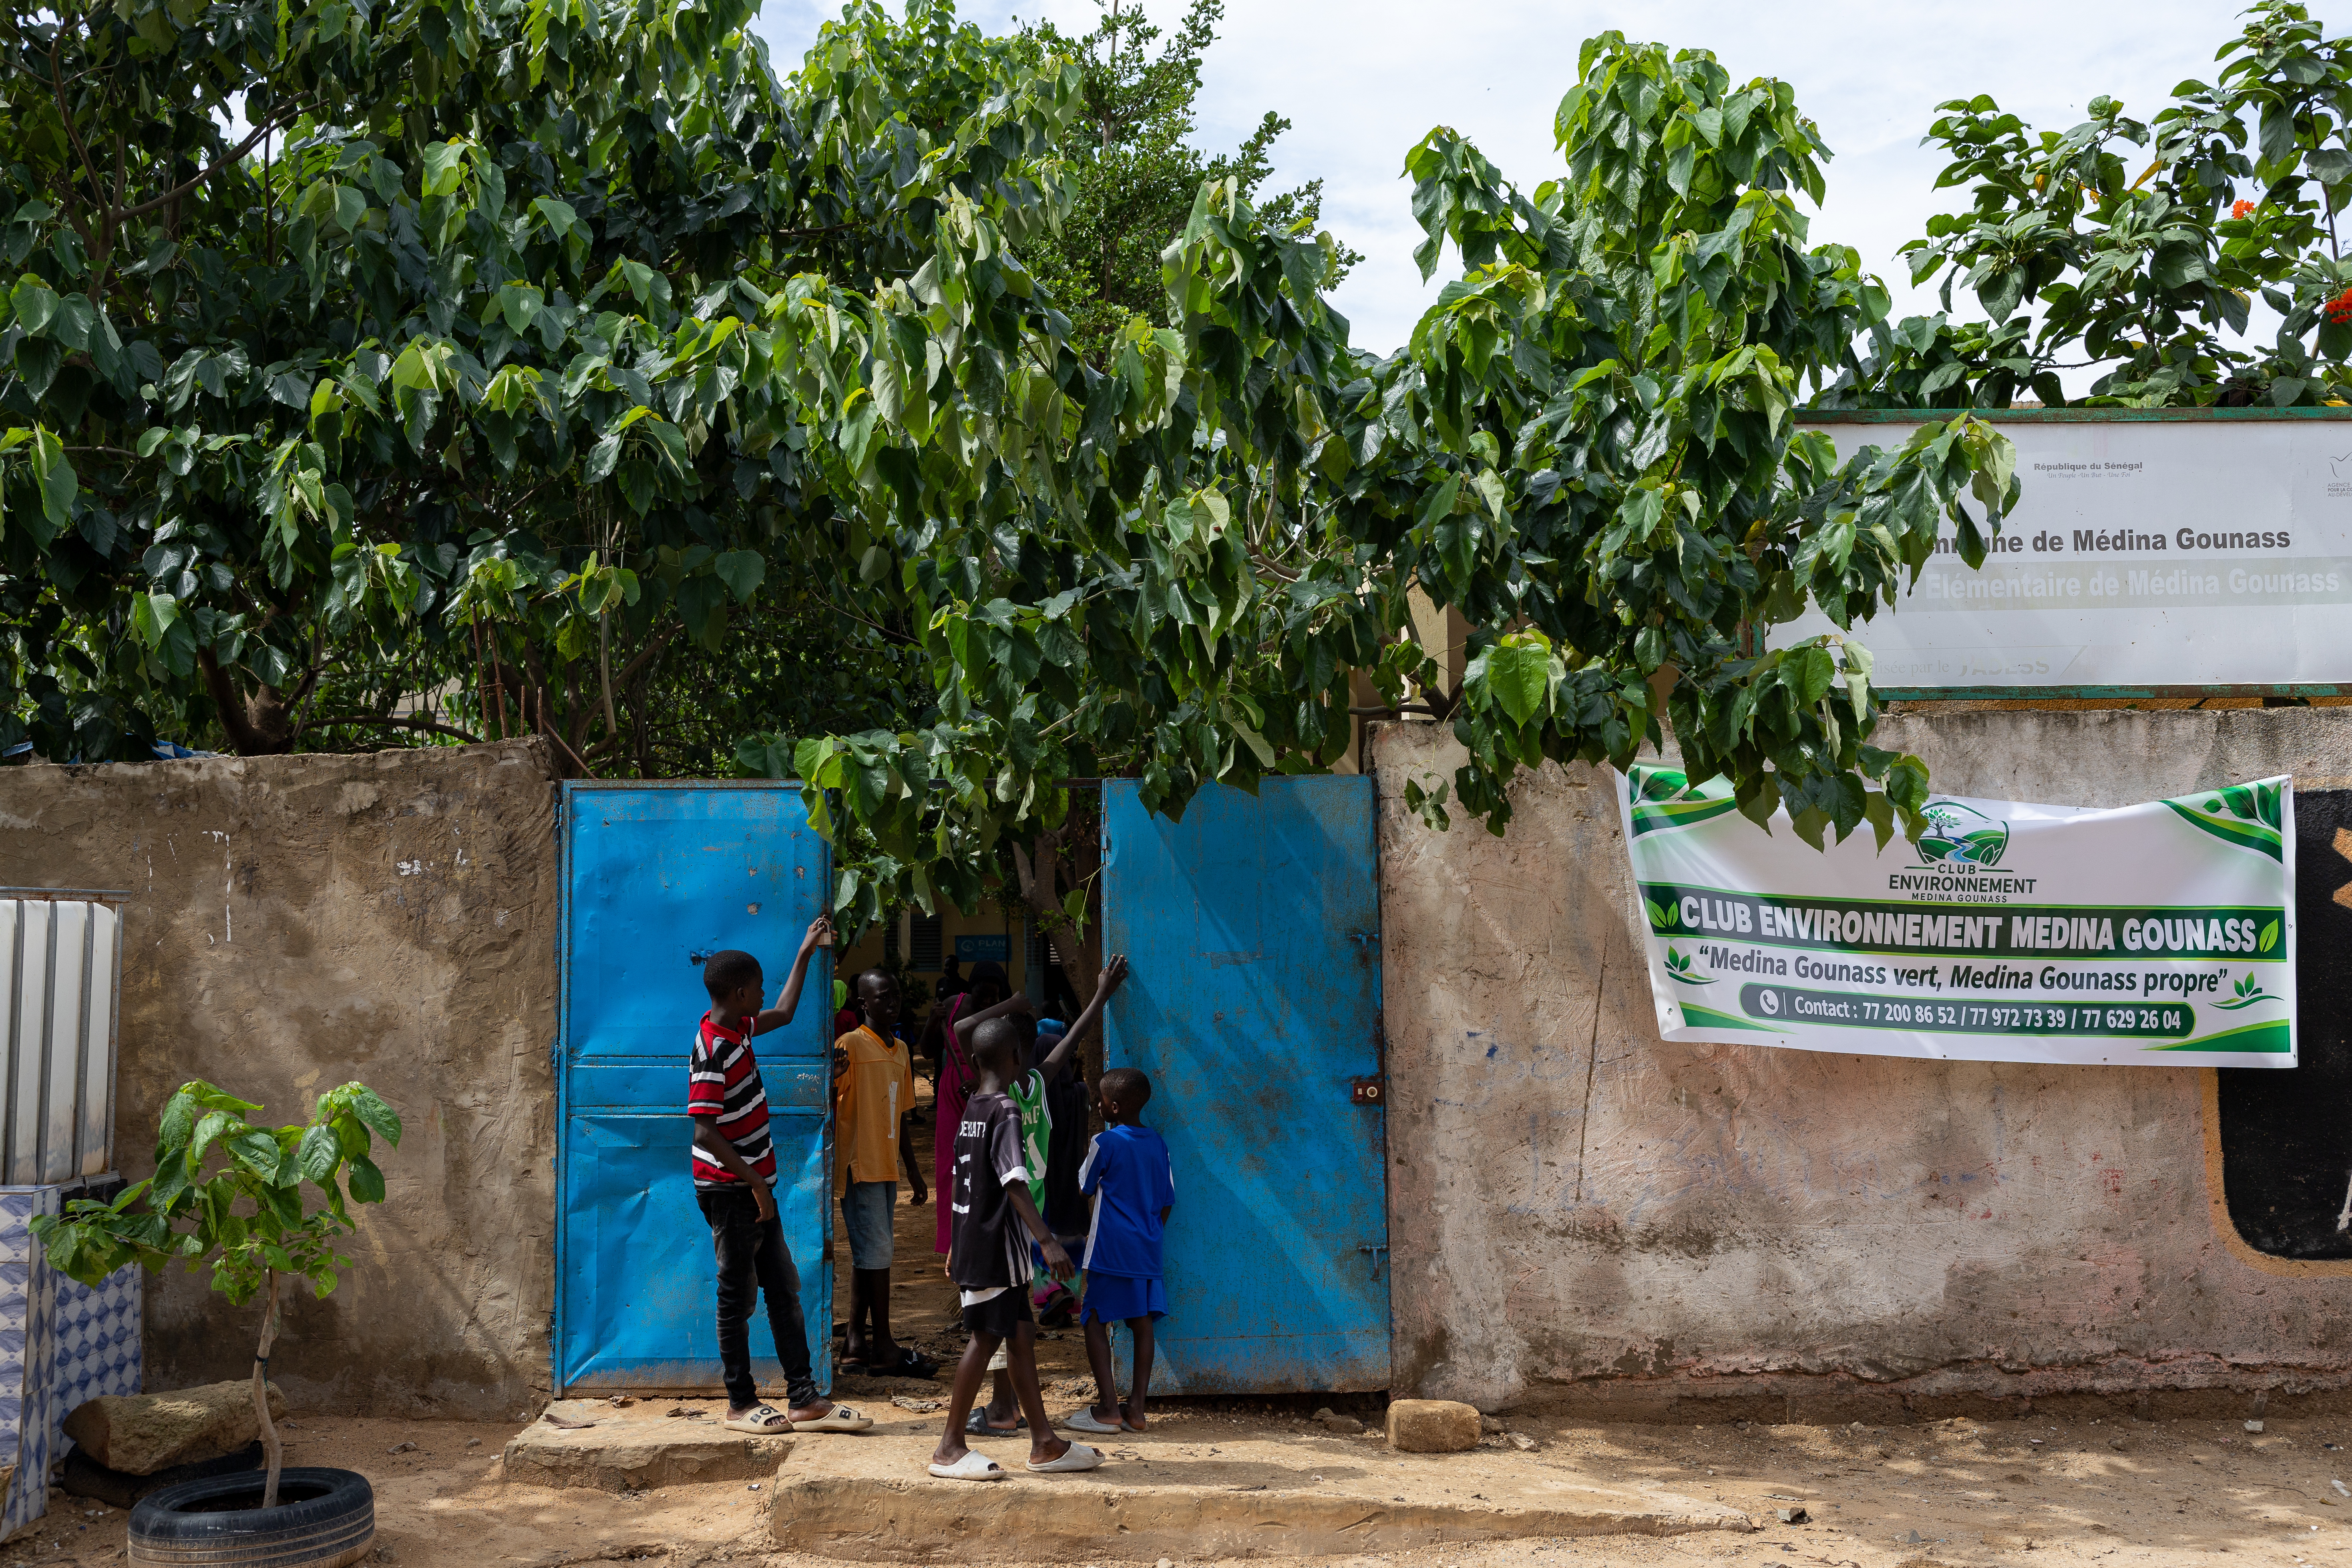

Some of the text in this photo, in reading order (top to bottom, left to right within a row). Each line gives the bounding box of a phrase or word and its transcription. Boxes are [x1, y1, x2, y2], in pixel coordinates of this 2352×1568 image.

[2034, 463, 2087, 472] République
[2105, 462, 2143, 470] Sénégal
[2058, 472, 2076, 480] Peuple
[2032, 531, 2064, 552] de
[2073, 529, 2167, 551] Médina
[2176, 528, 2291, 549] Gounass
[1926, 572, 2081, 599] Elémentaire
[2089, 571, 2119, 596] de
[2128, 568, 2219, 595] Médina
[2229, 568, 2340, 594] Gounass
[1911, 662, 1933, 677] par
[1937, 659, 1950, 673] le
[1938, 864, 1976, 874] CLUB
[1889, 874, 2037, 894] ENVIRONNEMENT
[1912, 893, 2007, 903] MEDINA GOUNASS
[1681, 896, 2256, 952] CLUB ENVIRONNEMENT MEDINA GOUNASS
[1794, 955, 1886, 985] Gounass
[1894, 965, 1942, 991] vert,
[1950, 965, 2033, 990] Medina
[2040, 965, 2137, 991] Gounass
[1795, 996, 1850, 1018] Contact
[1863, 1002, 1880, 1020] 77
[1884, 1003, 1911, 1022] 200
[1914, 1005, 1934, 1023] 86
[1937, 1006, 1956, 1024] 52
[1970, 1007, 1988, 1026] 77
[1992, 1008, 2020, 1027] 972
[2023, 1009, 2043, 1027] 73
[2047, 1009, 2066, 1028] 39
[2082, 1009, 2101, 1028] 77
[2107, 1010, 2135, 1029] 629
[2140, 1010, 2159, 1029] 26
[2163, 1010, 2181, 1029] 04
